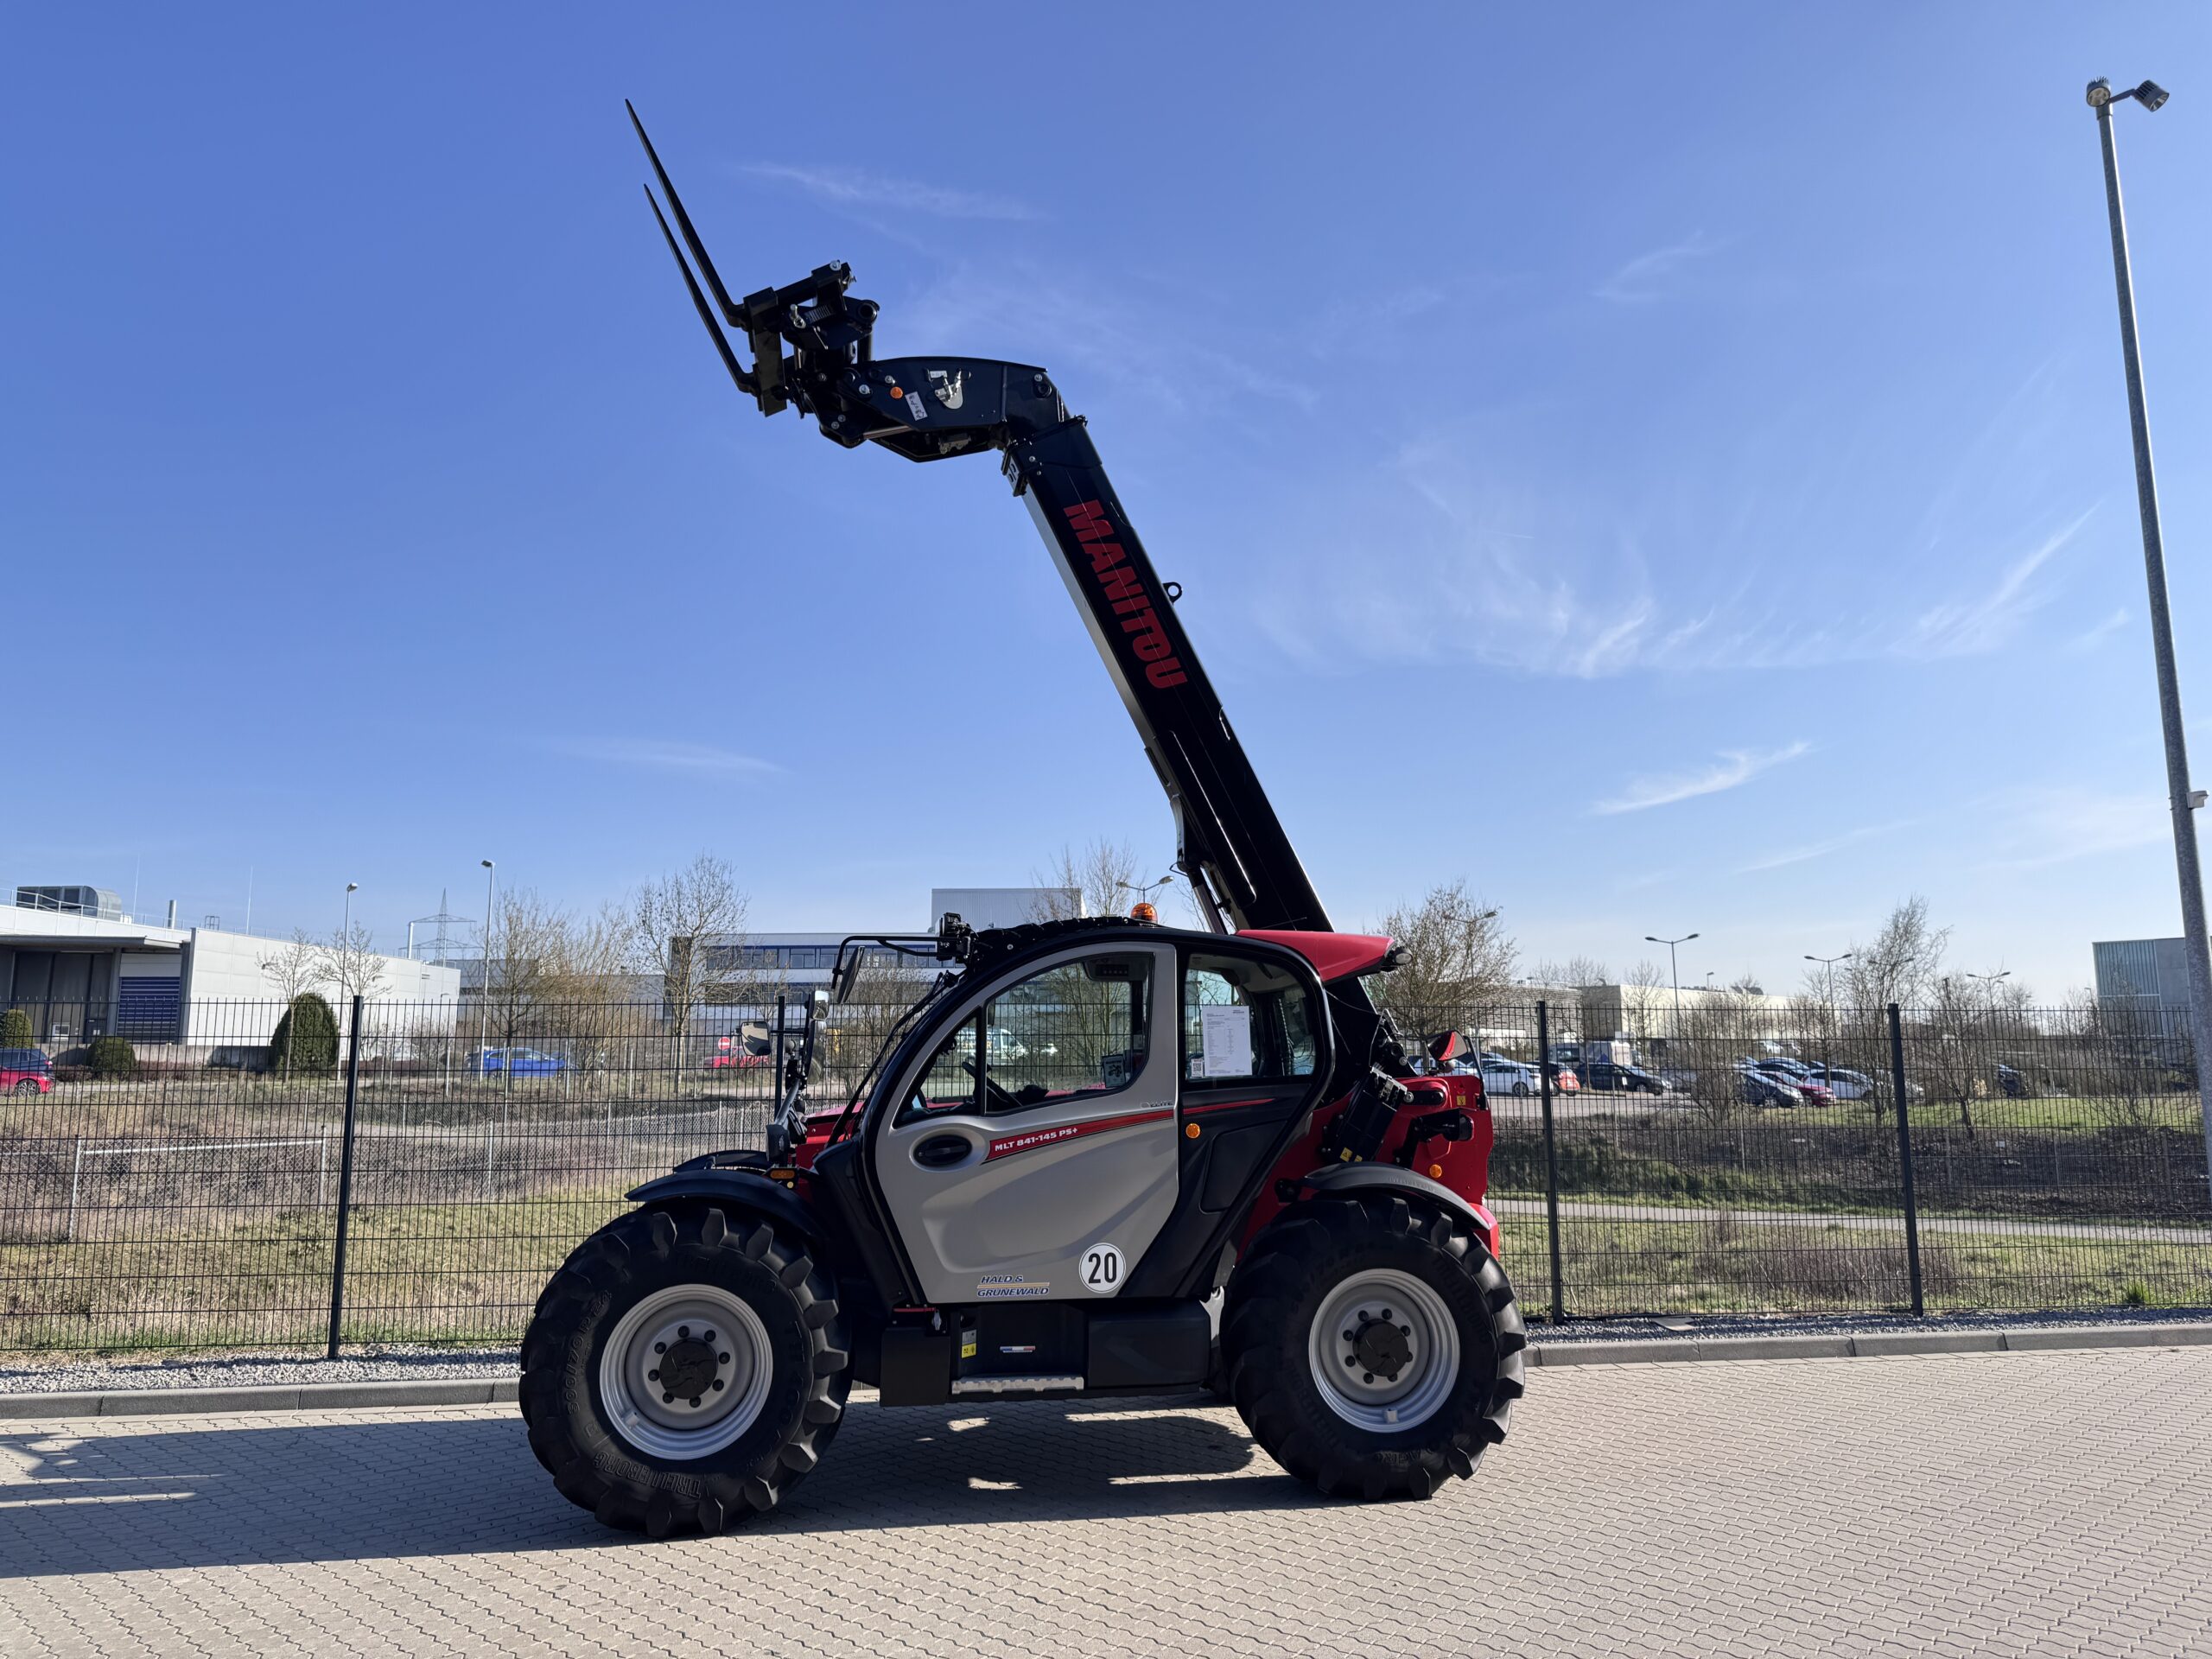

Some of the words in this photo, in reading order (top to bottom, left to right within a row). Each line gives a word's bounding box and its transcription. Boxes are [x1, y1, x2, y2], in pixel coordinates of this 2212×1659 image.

[1063, 499, 1188, 689] MANITOU
[995, 1141, 1015, 1152] MLT
[1016, 1132, 1057, 1147] 841-145
[1058, 1128, 1078, 1137] PS+
[981, 1275, 1013, 1284] HALD
[1088, 1252, 1117, 1284] 20
[977, 1287, 1049, 1297] GRUNEWALD
[593, 1452, 702, 1499] TRELLEBORG
